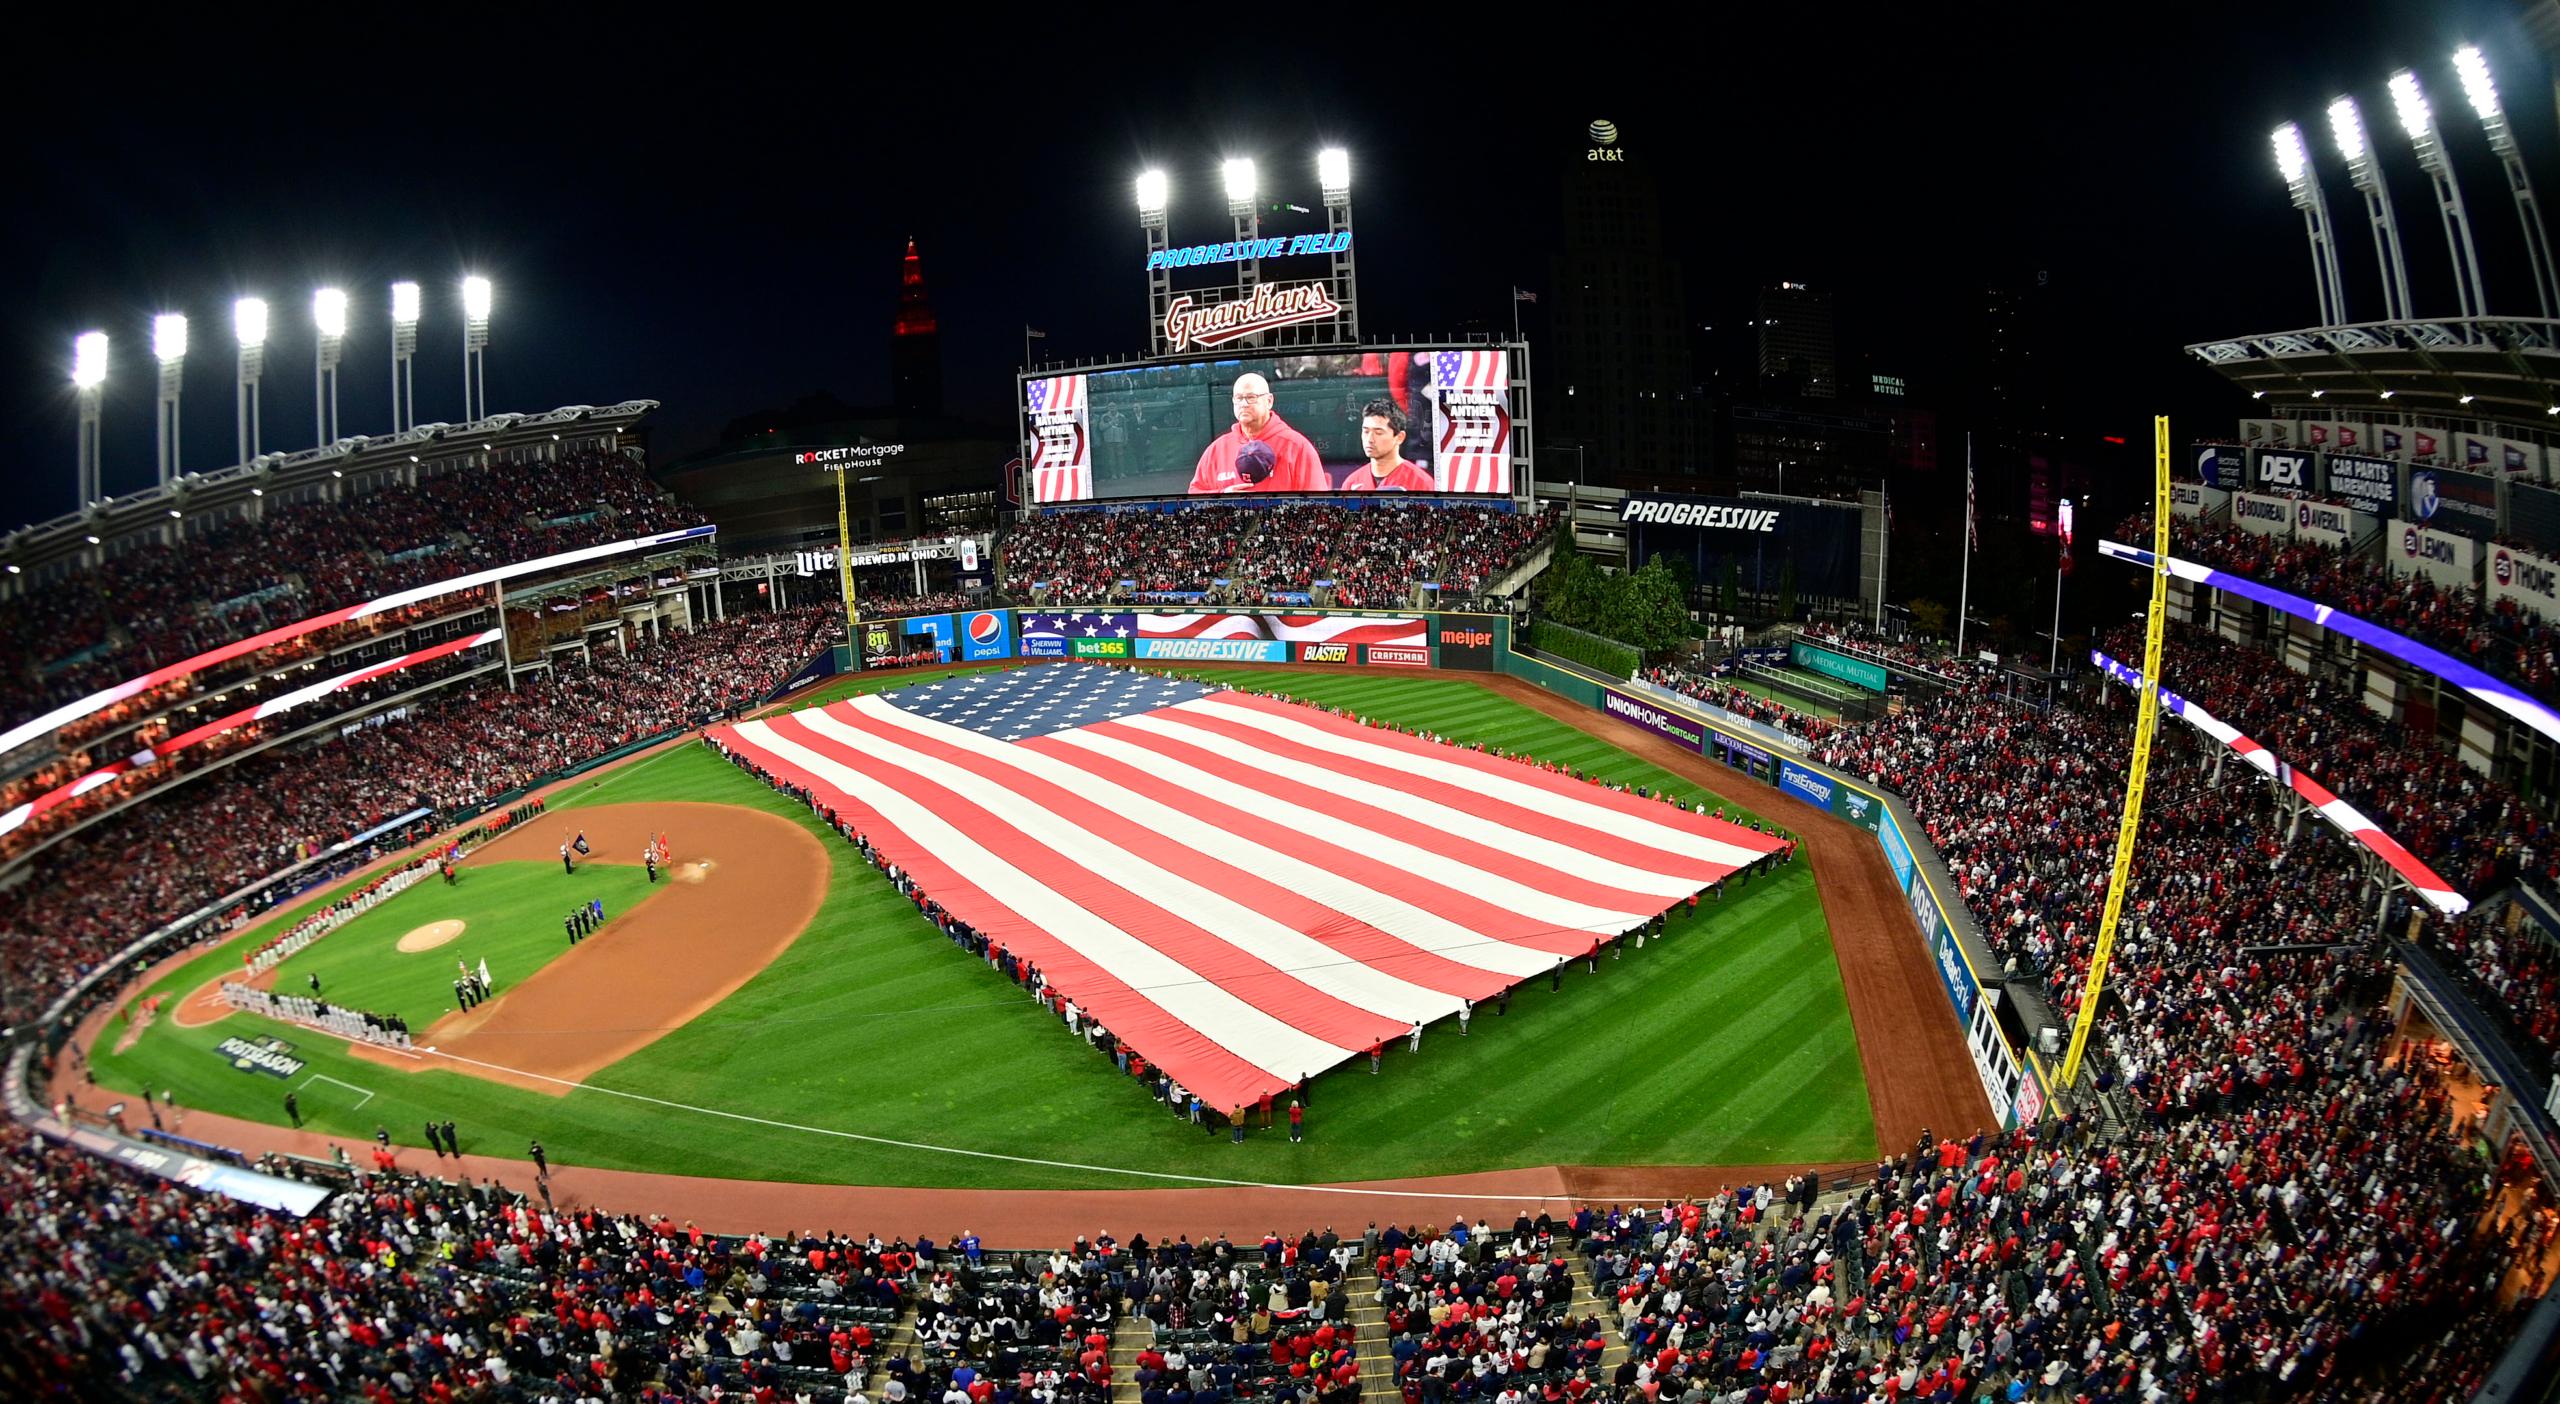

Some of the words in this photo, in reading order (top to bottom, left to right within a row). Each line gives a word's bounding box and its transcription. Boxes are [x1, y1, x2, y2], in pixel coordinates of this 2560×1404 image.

[1587, 147, 1624, 162] at&t
[1146, 237, 1286, 271] PROGRESSIVE
[1288, 231, 1352, 255] FIELD
[1164, 282, 1341, 352] Guardians
[1872, 375, 1905, 387] MEDICAL
[1873, 384, 1905, 396] MUTUAL
[1446, 392, 1500, 405] NATIONAL
[1450, 405, 1496, 417] ANTHEM
[1039, 424, 1075, 437] ANTHEM
[795, 448, 848, 464] ROCKET
[850, 444, 904, 457] Mortgage
[2260, 455, 2304, 485] DEX
[2332, 458, 2353, 476] CAR
[2354, 461, 2389, 482] PARTS
[2176, 488, 2199, 505] FELLER
[2329, 476, 2393, 501] WAREHOUSE
[1622, 500, 1780, 532] PROGRESSIVE
[2247, 500, 2286, 522] BOUDREAU
[2312, 509, 2346, 534] AVERILL
[851, 553, 896, 567] BREWED
[898, 551, 909, 563] IN
[911, 550, 938, 561] OHIO
[2419, 535, 2455, 566] LEMON
[795, 551, 834, 577] Lite
[2513, 559, 2556, 600] THOME
[868, 632, 889, 648] 811
[1031, 639, 1062, 648] SHERWIN
[1077, 641, 1124, 654] bet365
[1440, 628, 1493, 649] meijer
[974, 645, 1001, 657] pepsi
[1146, 640, 1270, 660] PROGRESSIVE
[1812, 655, 1845, 673] MEDICAL
[1846, 664, 1878, 683] MUTUAL
[1631, 675, 1651, 691] MOEN
[1676, 693, 1698, 709] MOEN
[1726, 712, 1751, 728] MOEN
[1666, 724, 1700, 744] MORTGAGE
[1715, 732, 1742, 751] LECOM
[1783, 733, 1811, 752] MOEN
[1783, 767, 1831, 798] FirstEnergy
[1911, 875, 1937, 941] MOEN
[219, 1037, 304, 1075] POSTSEASON
[1981, 1063, 2001, 1114] CLIFFS
